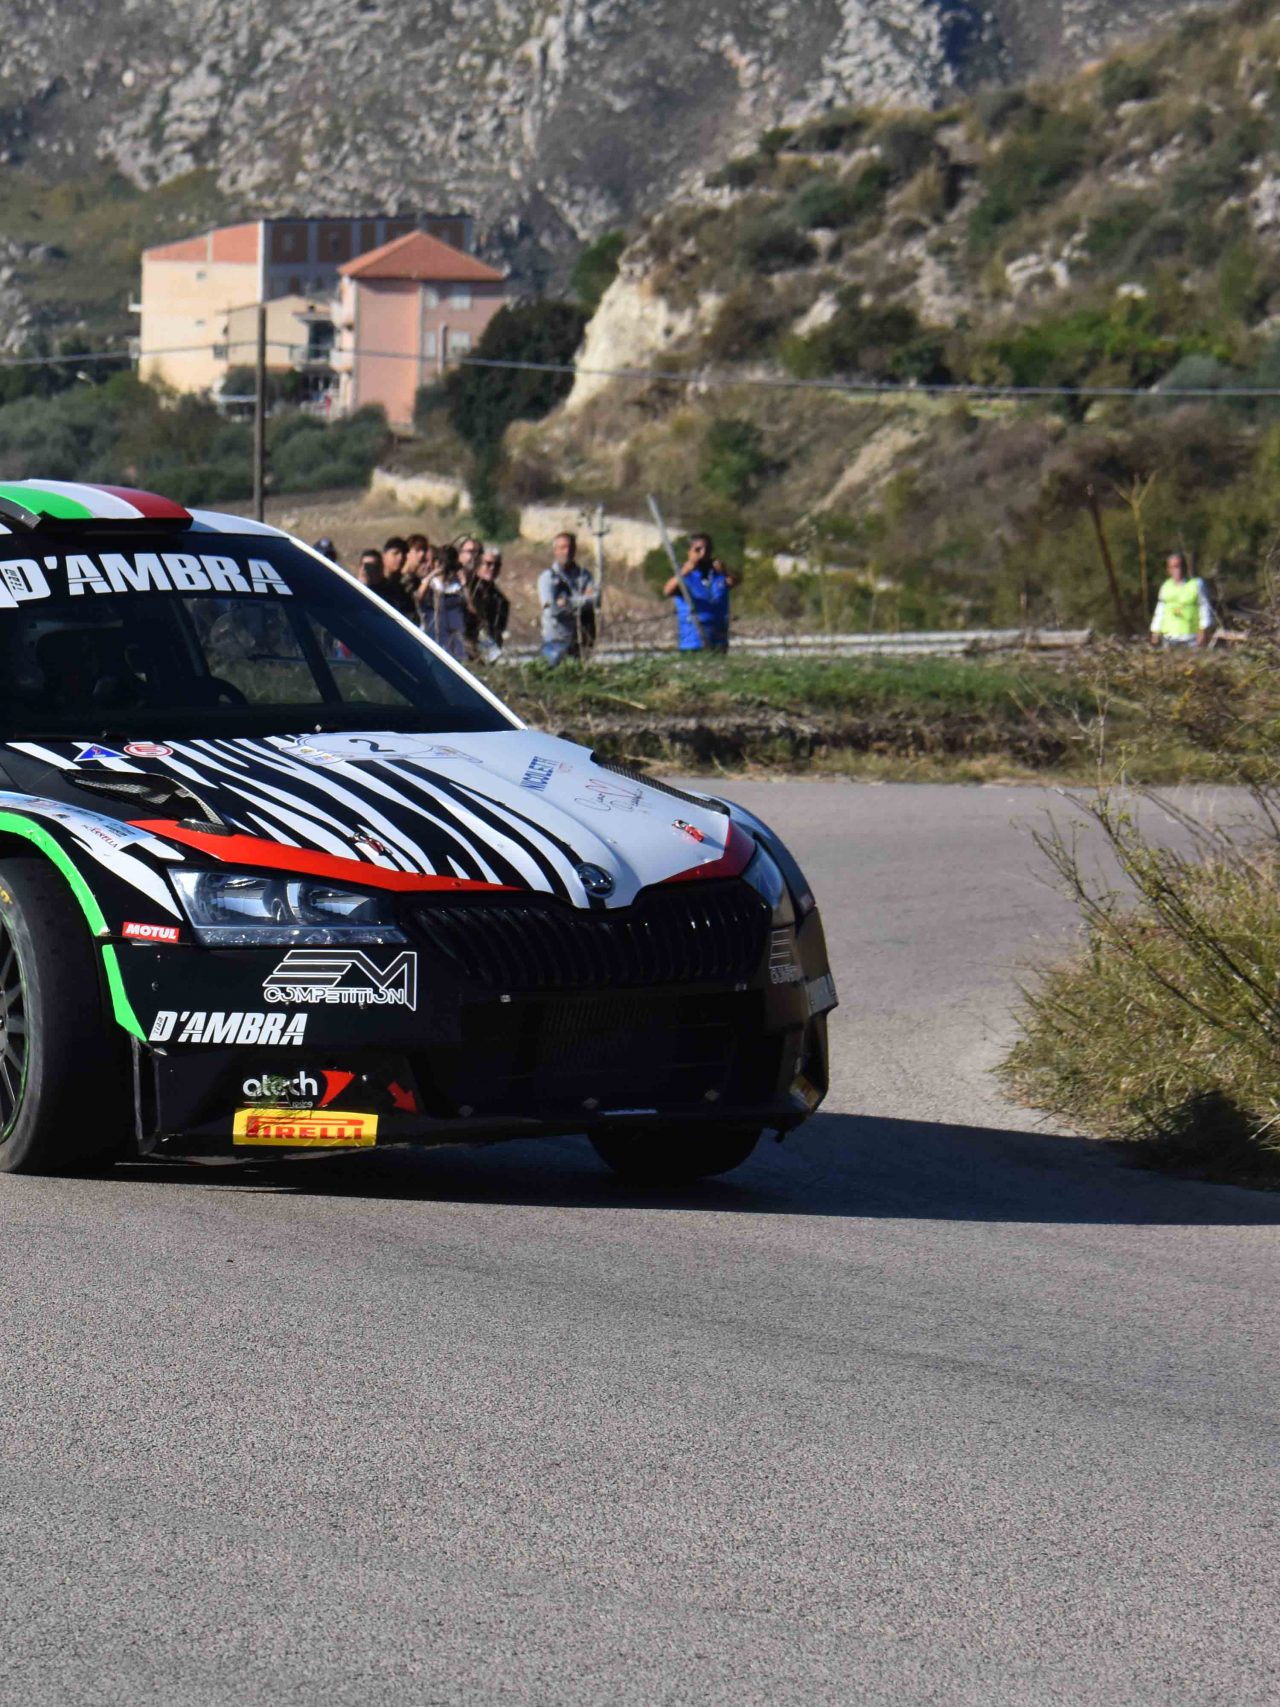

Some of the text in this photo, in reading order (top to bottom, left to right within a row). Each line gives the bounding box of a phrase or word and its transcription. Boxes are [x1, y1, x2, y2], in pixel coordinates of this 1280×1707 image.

[348, 739, 395, 752] 2
[125, 924, 177, 940] MOTUL
[263, 986, 405, 1005] COMPETITION
[148, 1010, 308, 1045] D'AMBRA
[246, 1116, 365, 1140] PIRELLI
